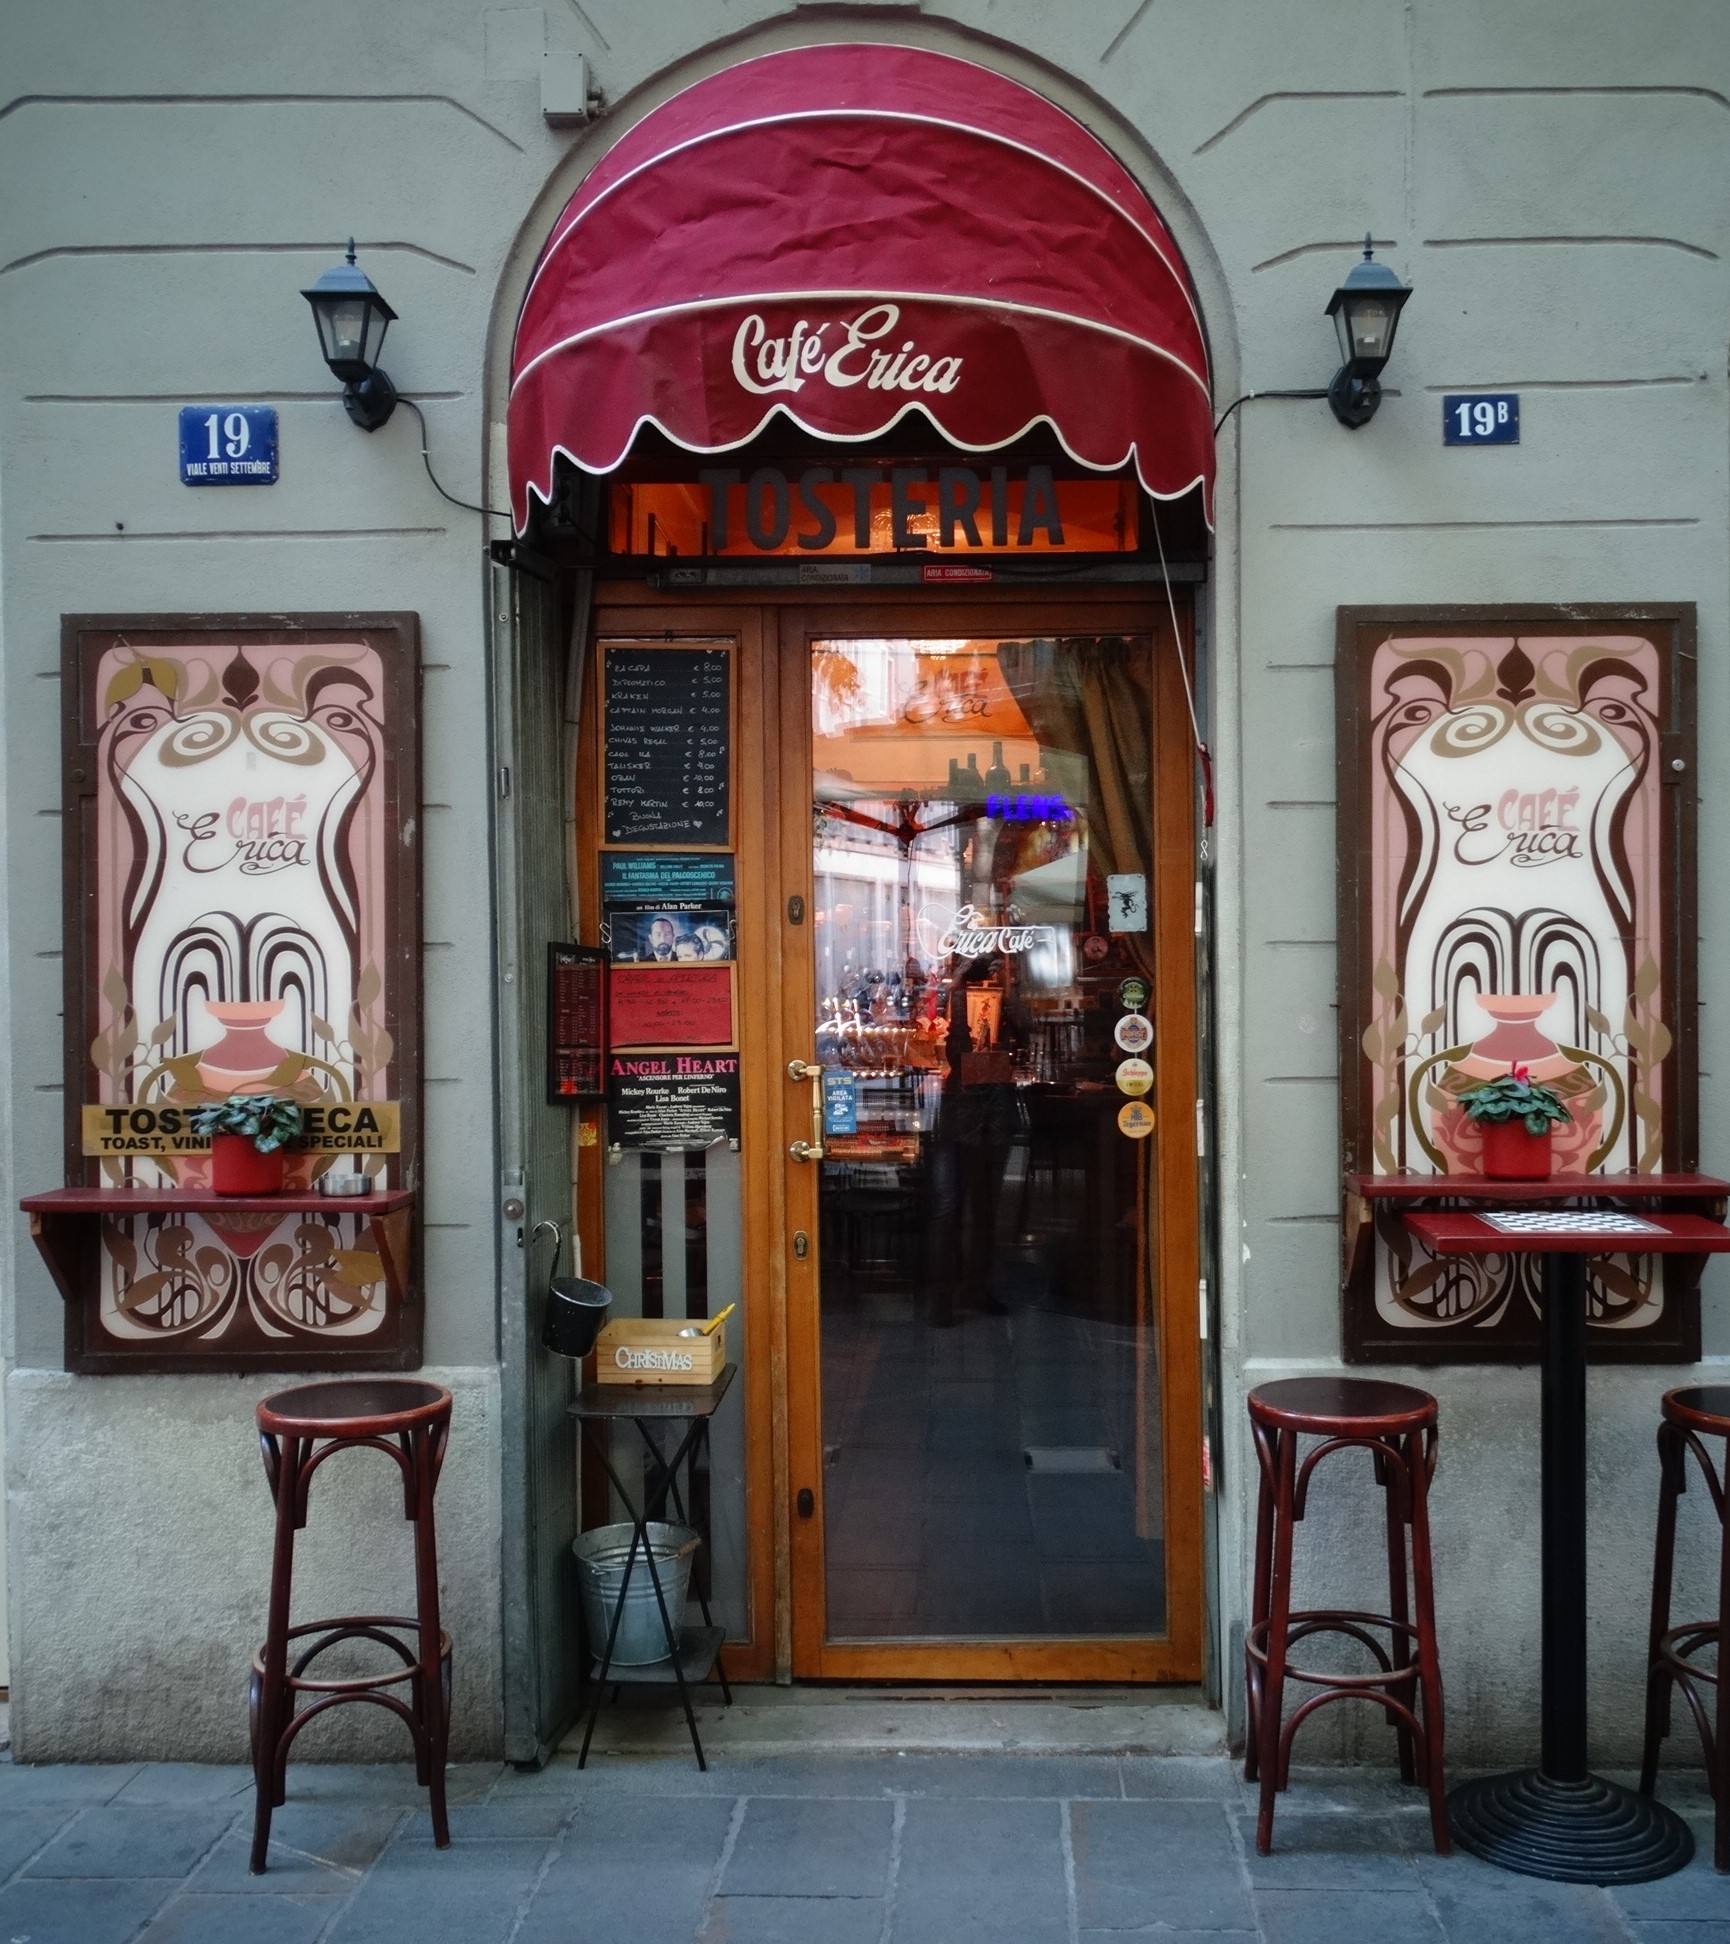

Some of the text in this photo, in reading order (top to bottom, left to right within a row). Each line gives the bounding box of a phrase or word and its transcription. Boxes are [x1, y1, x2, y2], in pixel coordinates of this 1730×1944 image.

[732, 303, 961, 394] Café Erica
[204, 413, 250, 459] 19
[186, 461, 271, 477] VIALE VENTI SETTEMBRE
[699, 464, 1066, 550] TOSTERIA
[926, 569, 942, 577] ARIA
[611, 692, 649, 701] KRAKEN
[651, 707, 683, 715] MORGAN
[610, 774, 636, 782] OBAN
[610, 787, 645, 795] TOTTORI
[612, 799, 635, 808] REMY
[640, 800, 668, 808] MARTIN
[1497, 785, 1581, 831] CAFÉ
[226, 793, 309, 840] CAFÉ
[629, 811, 662, 821] BUONA
[622, 820, 691, 836] DEGUSTAZIONE
[1443, 802, 1583, 868] Erica
[172, 812, 311, 876] Erica
[627, 861, 656, 869] WILLIAMS
[628, 872, 659, 880] FANTASMA
[660, 871, 671, 879] DEL
[679, 902, 702, 910] Parker
[928, 904, 1034, 958] Erica Café
[611, 1057, 738, 1076] ANGEL HEART
[827, 1077, 852, 1086] STS
[621, 1088, 646, 1097] Mickey
[645, 1087, 670, 1095] Rourke
[678, 1086, 701, 1094] Robert
[711, 1085, 727, 1093] Niro
[101, 1136, 166, 1152] TOAST,
[300, 1136, 383, 1148] SPECIALI
[615, 1346, 693, 1371] CHRISTMAS
